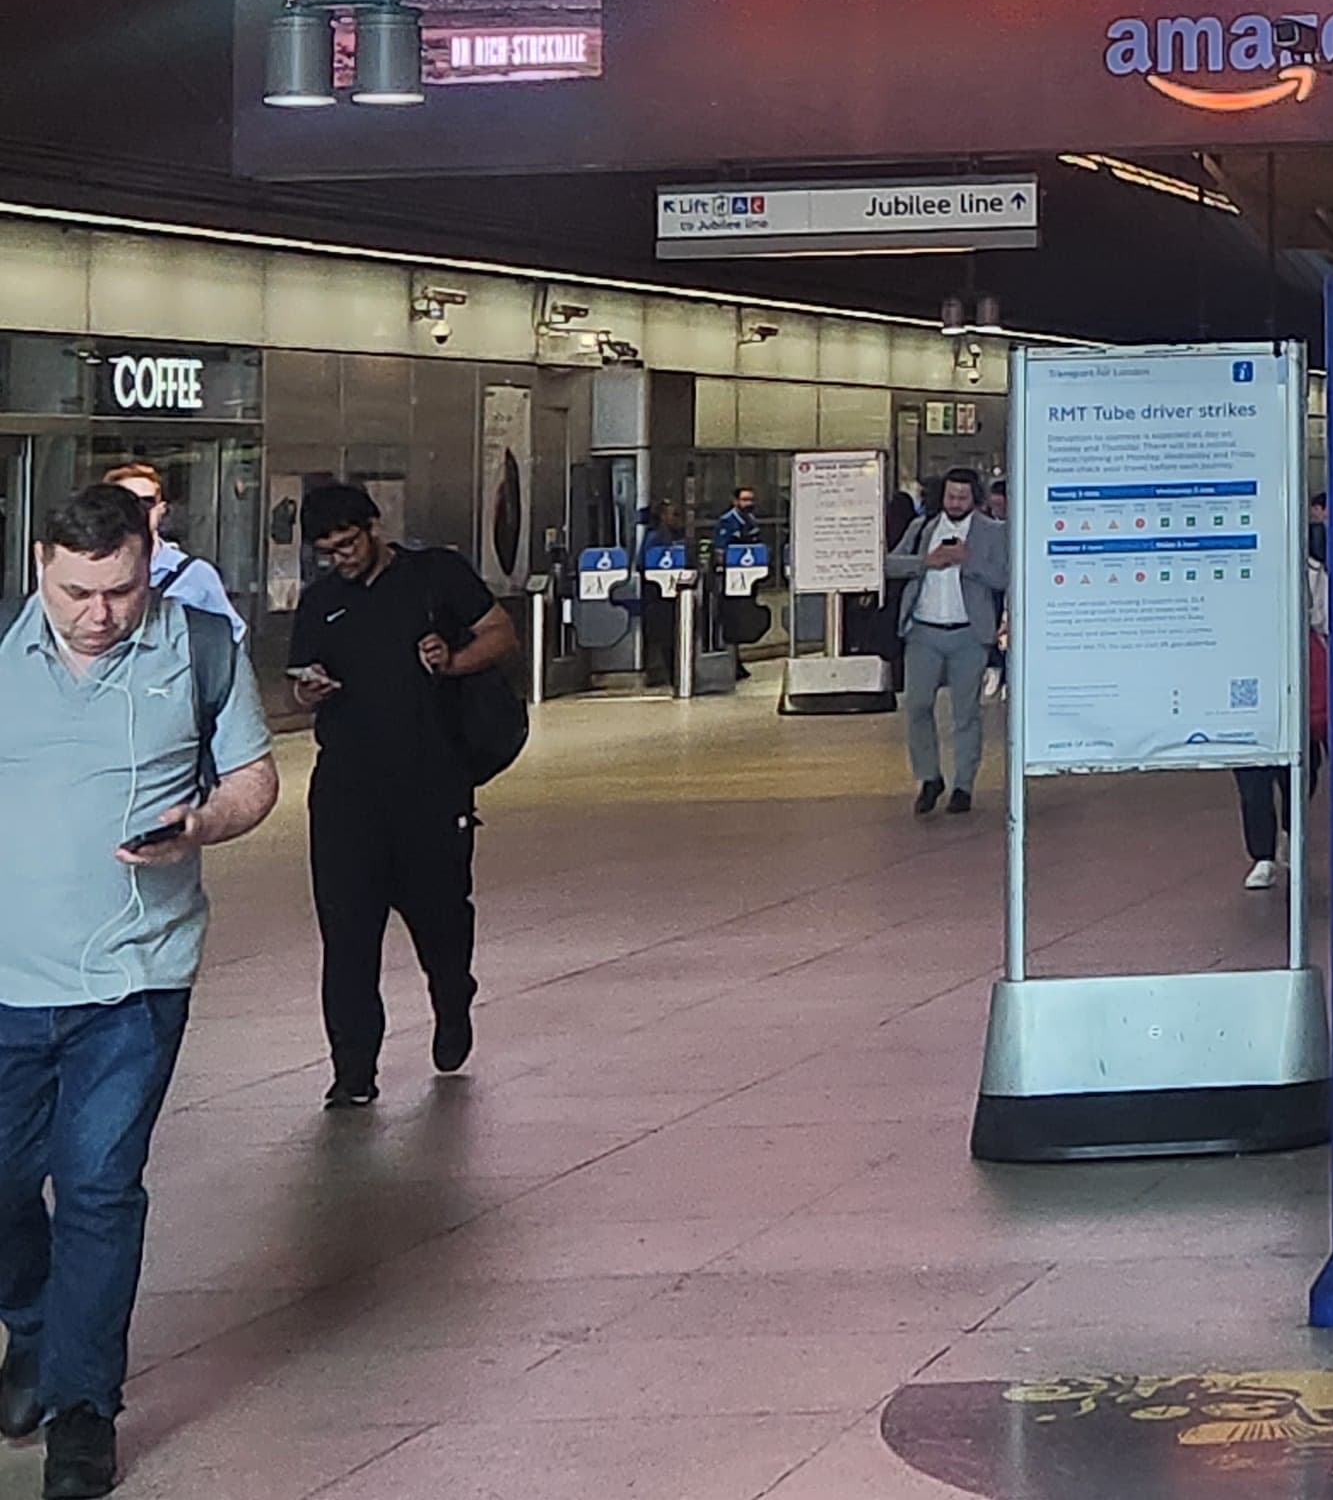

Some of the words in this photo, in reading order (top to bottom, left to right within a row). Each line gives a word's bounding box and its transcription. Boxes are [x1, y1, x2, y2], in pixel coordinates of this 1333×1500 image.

[680, 199, 709, 216] Lift
[865, 194, 952, 219] Jubilee
[960, 192, 1004, 214] line
[112, 357, 203, 410] COFFEE
[1048, 406, 1088, 422] RMT
[1092, 405, 1136, 421] Tube
[1140, 403, 1194, 419] driver
[1199, 402, 1257, 418] strikes
